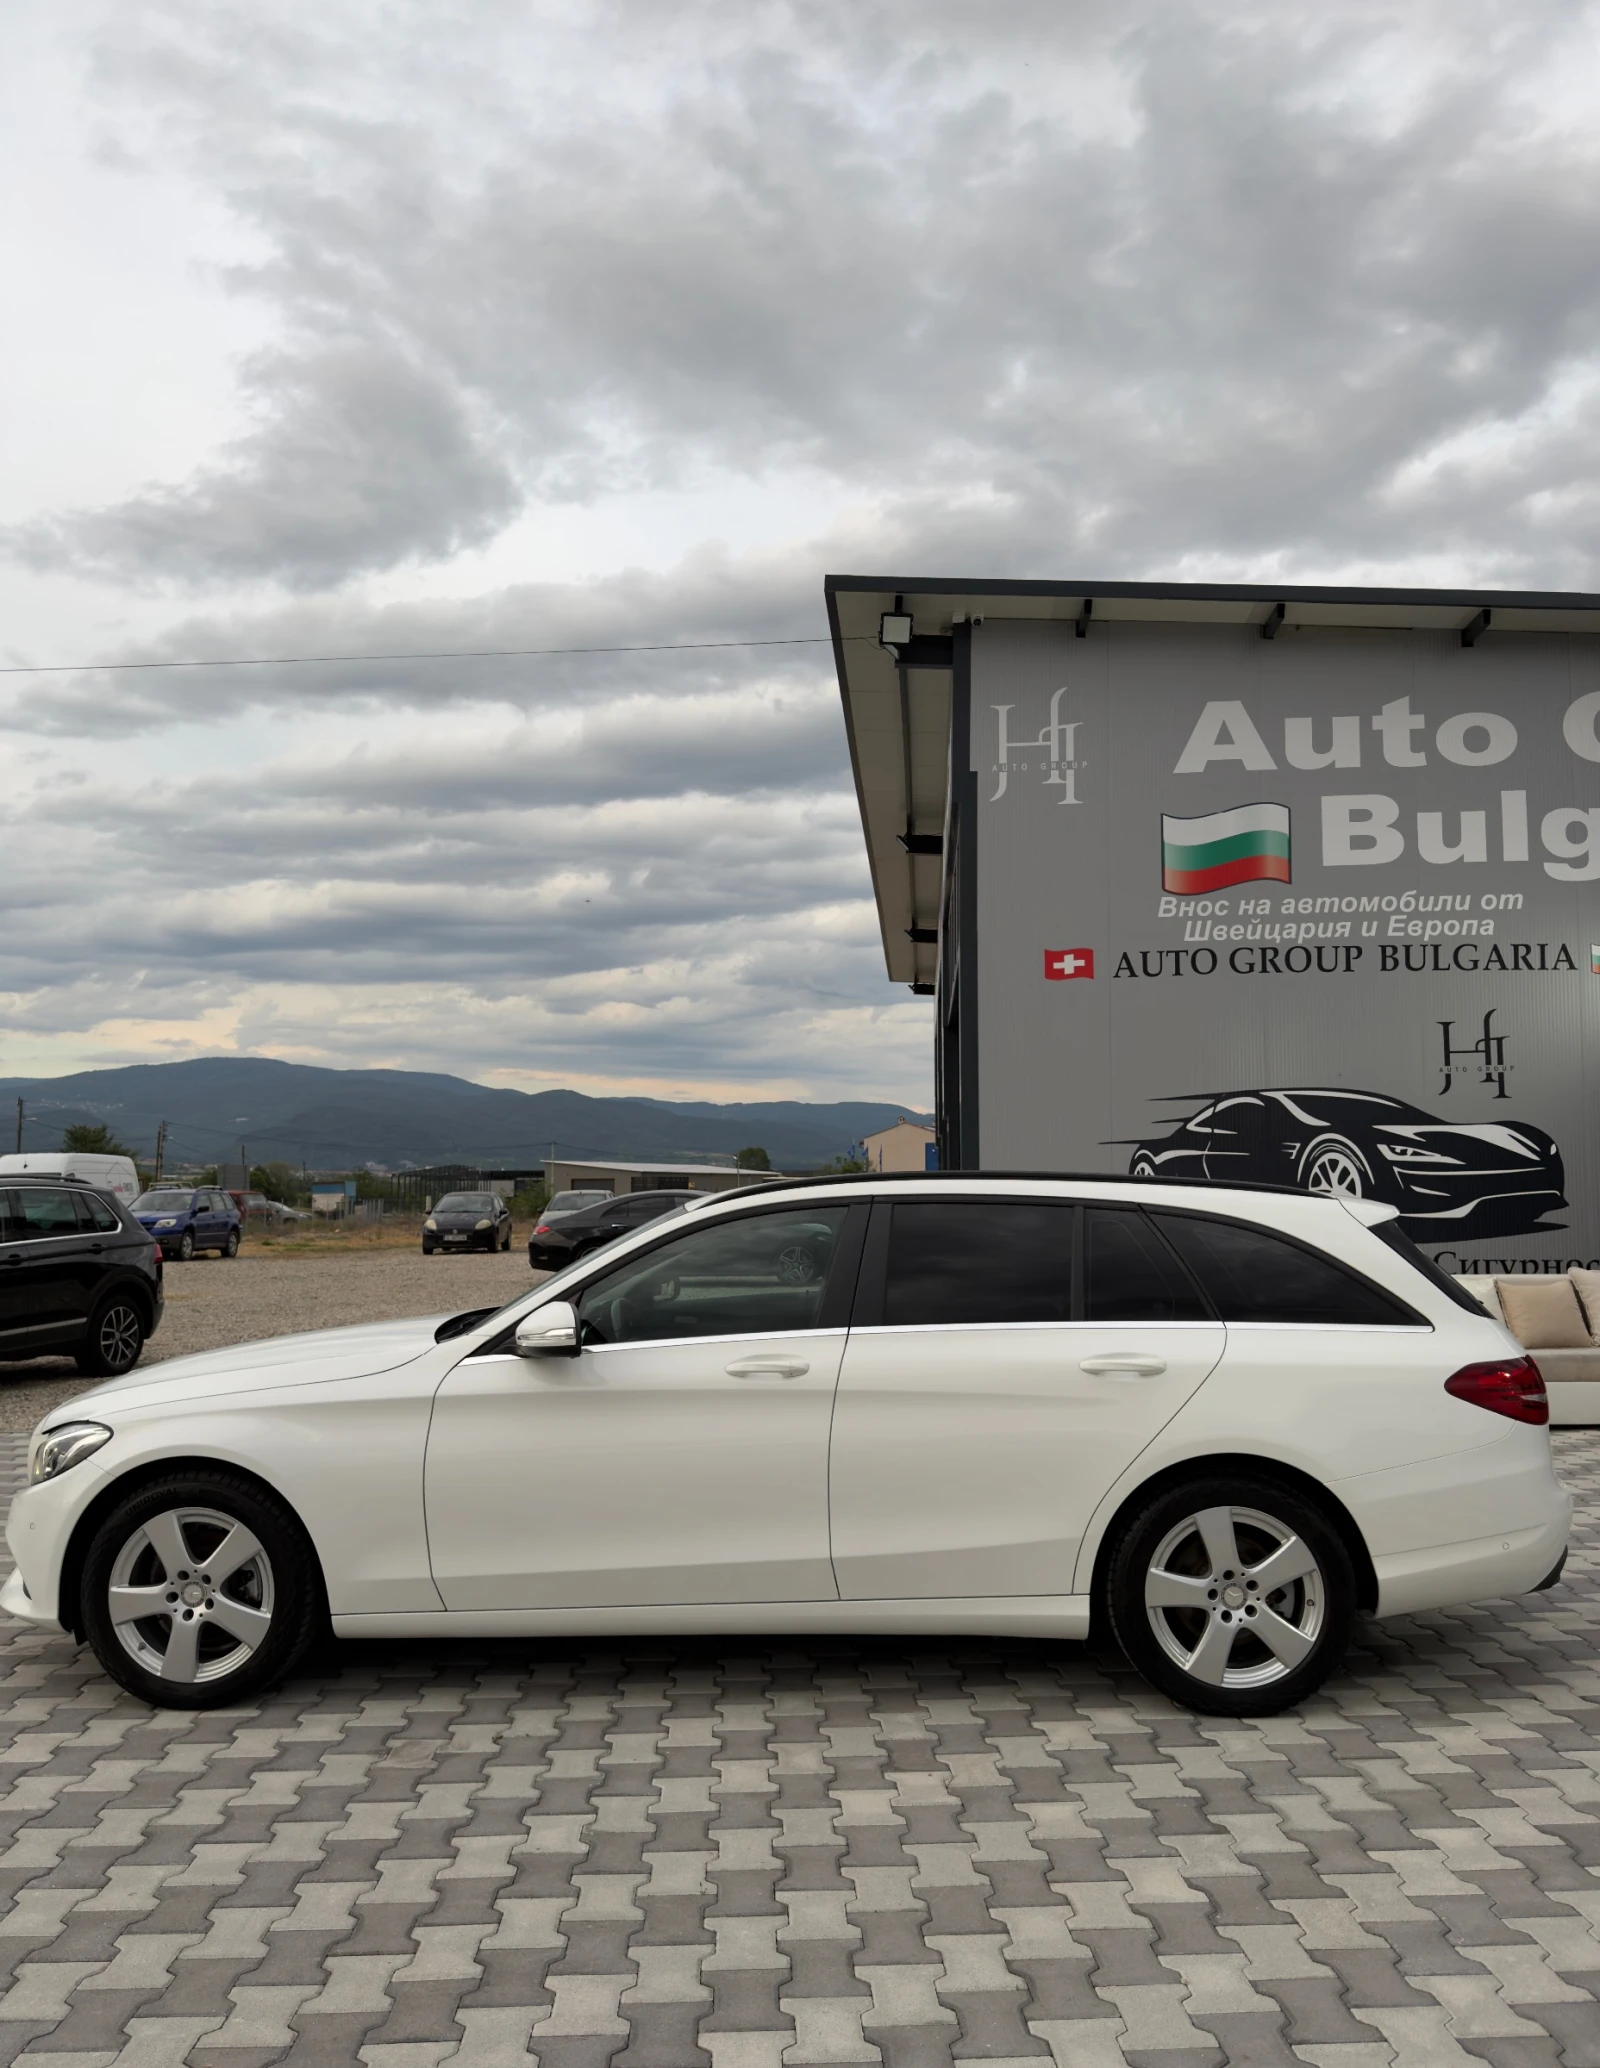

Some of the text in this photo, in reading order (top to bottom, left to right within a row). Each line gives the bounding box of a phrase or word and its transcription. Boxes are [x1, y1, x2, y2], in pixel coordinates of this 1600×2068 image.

[1173, 695, 1518, 773] Auto
[991, 761, 1088, 772] AUTO GROUP
[1157, 889, 1524, 918] Внос на автомобили от
[1183, 914, 1495, 944] Швейцария и Европа
[1112, 943, 1578, 979] AUTO GROUP BULGARIA
